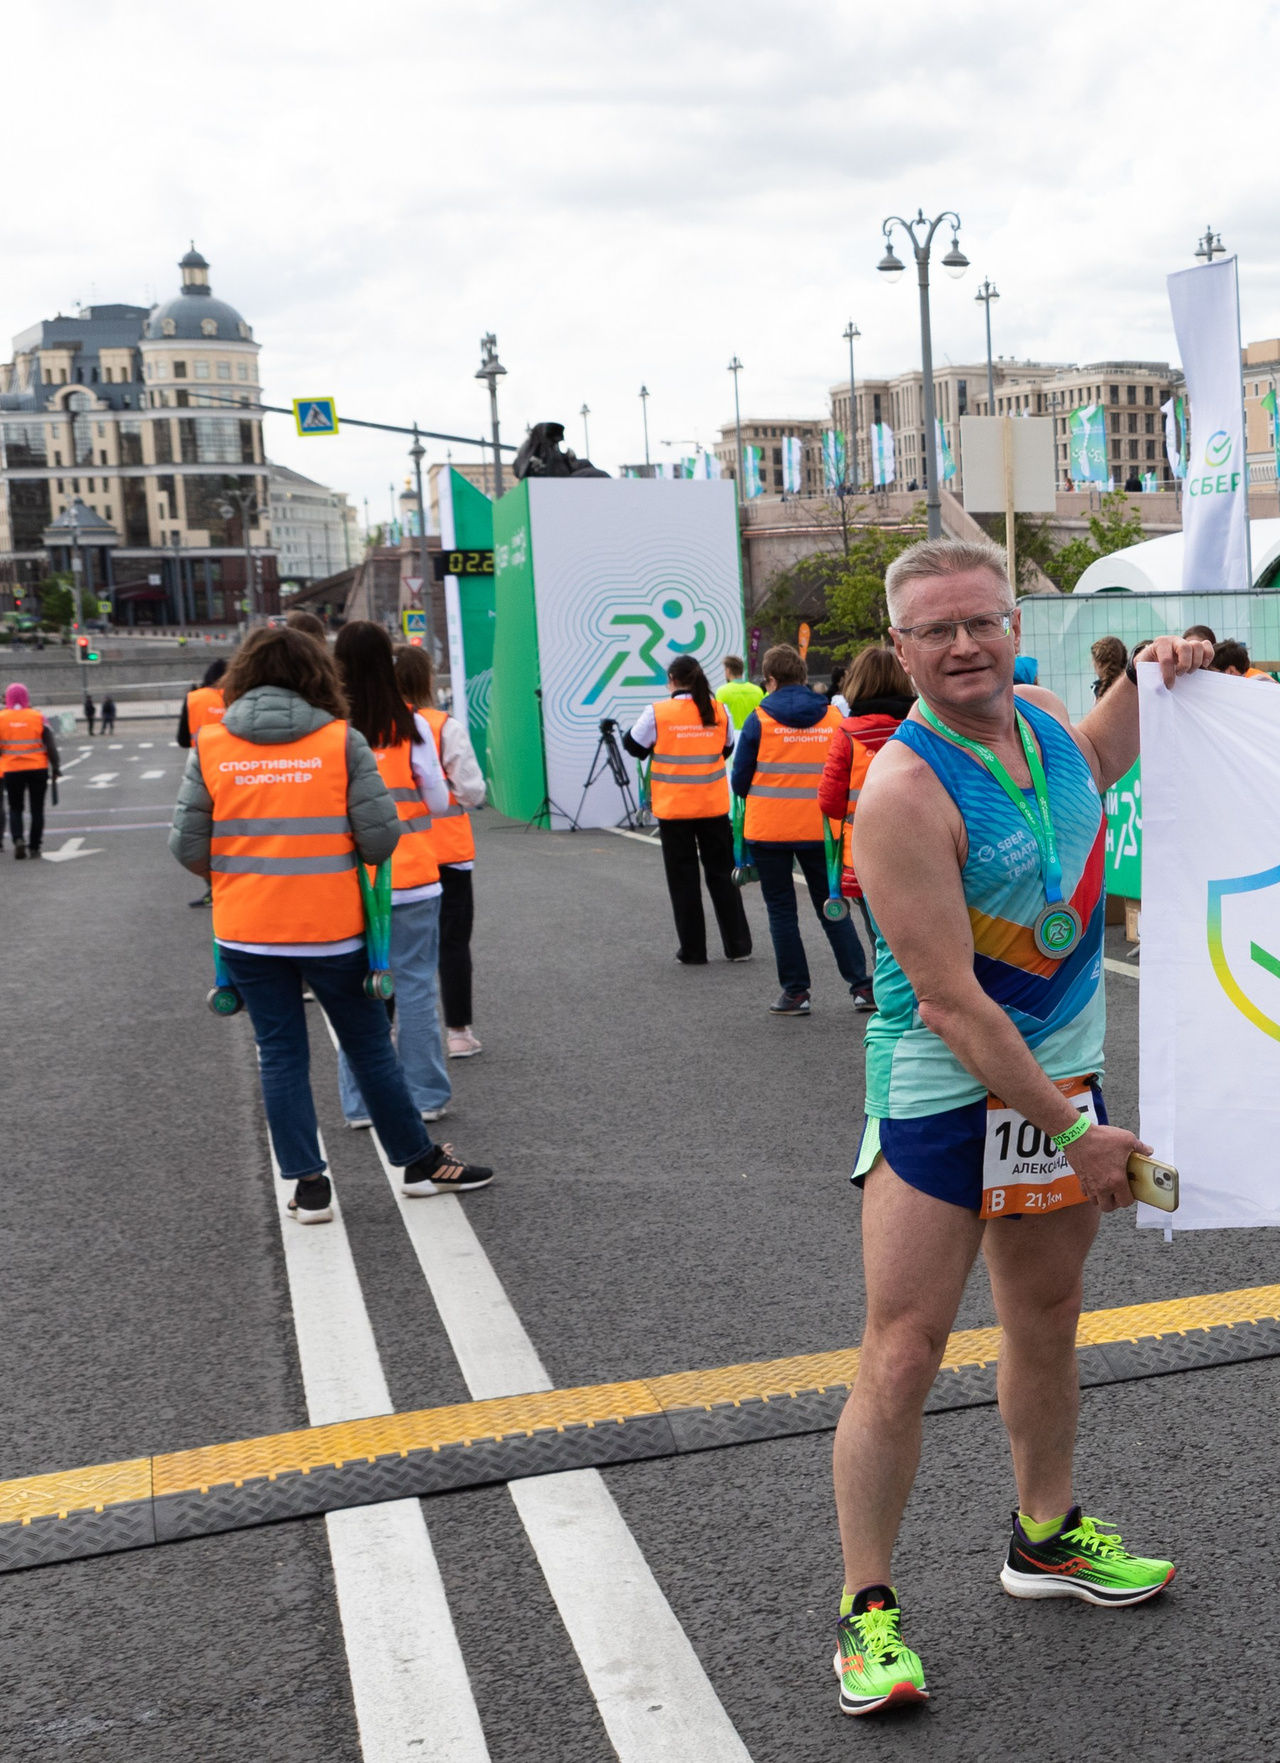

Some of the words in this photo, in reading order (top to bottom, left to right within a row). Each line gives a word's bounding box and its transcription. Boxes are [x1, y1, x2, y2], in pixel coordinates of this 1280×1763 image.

[1189, 472, 1241, 497] СБЕР
[783, 735, 829, 743] ВОЛОНТЁР
[219, 757, 322, 773] СПОРТИВНЫЙ
[234, 771, 312, 786] ВОЛОНТЁР
[997, 830, 1025, 853] SBER
[1002, 839, 1038, 866] TRIATH
[1006, 857, 1036, 880] TEAM
[1053, 1133, 1071, 1146] 025
